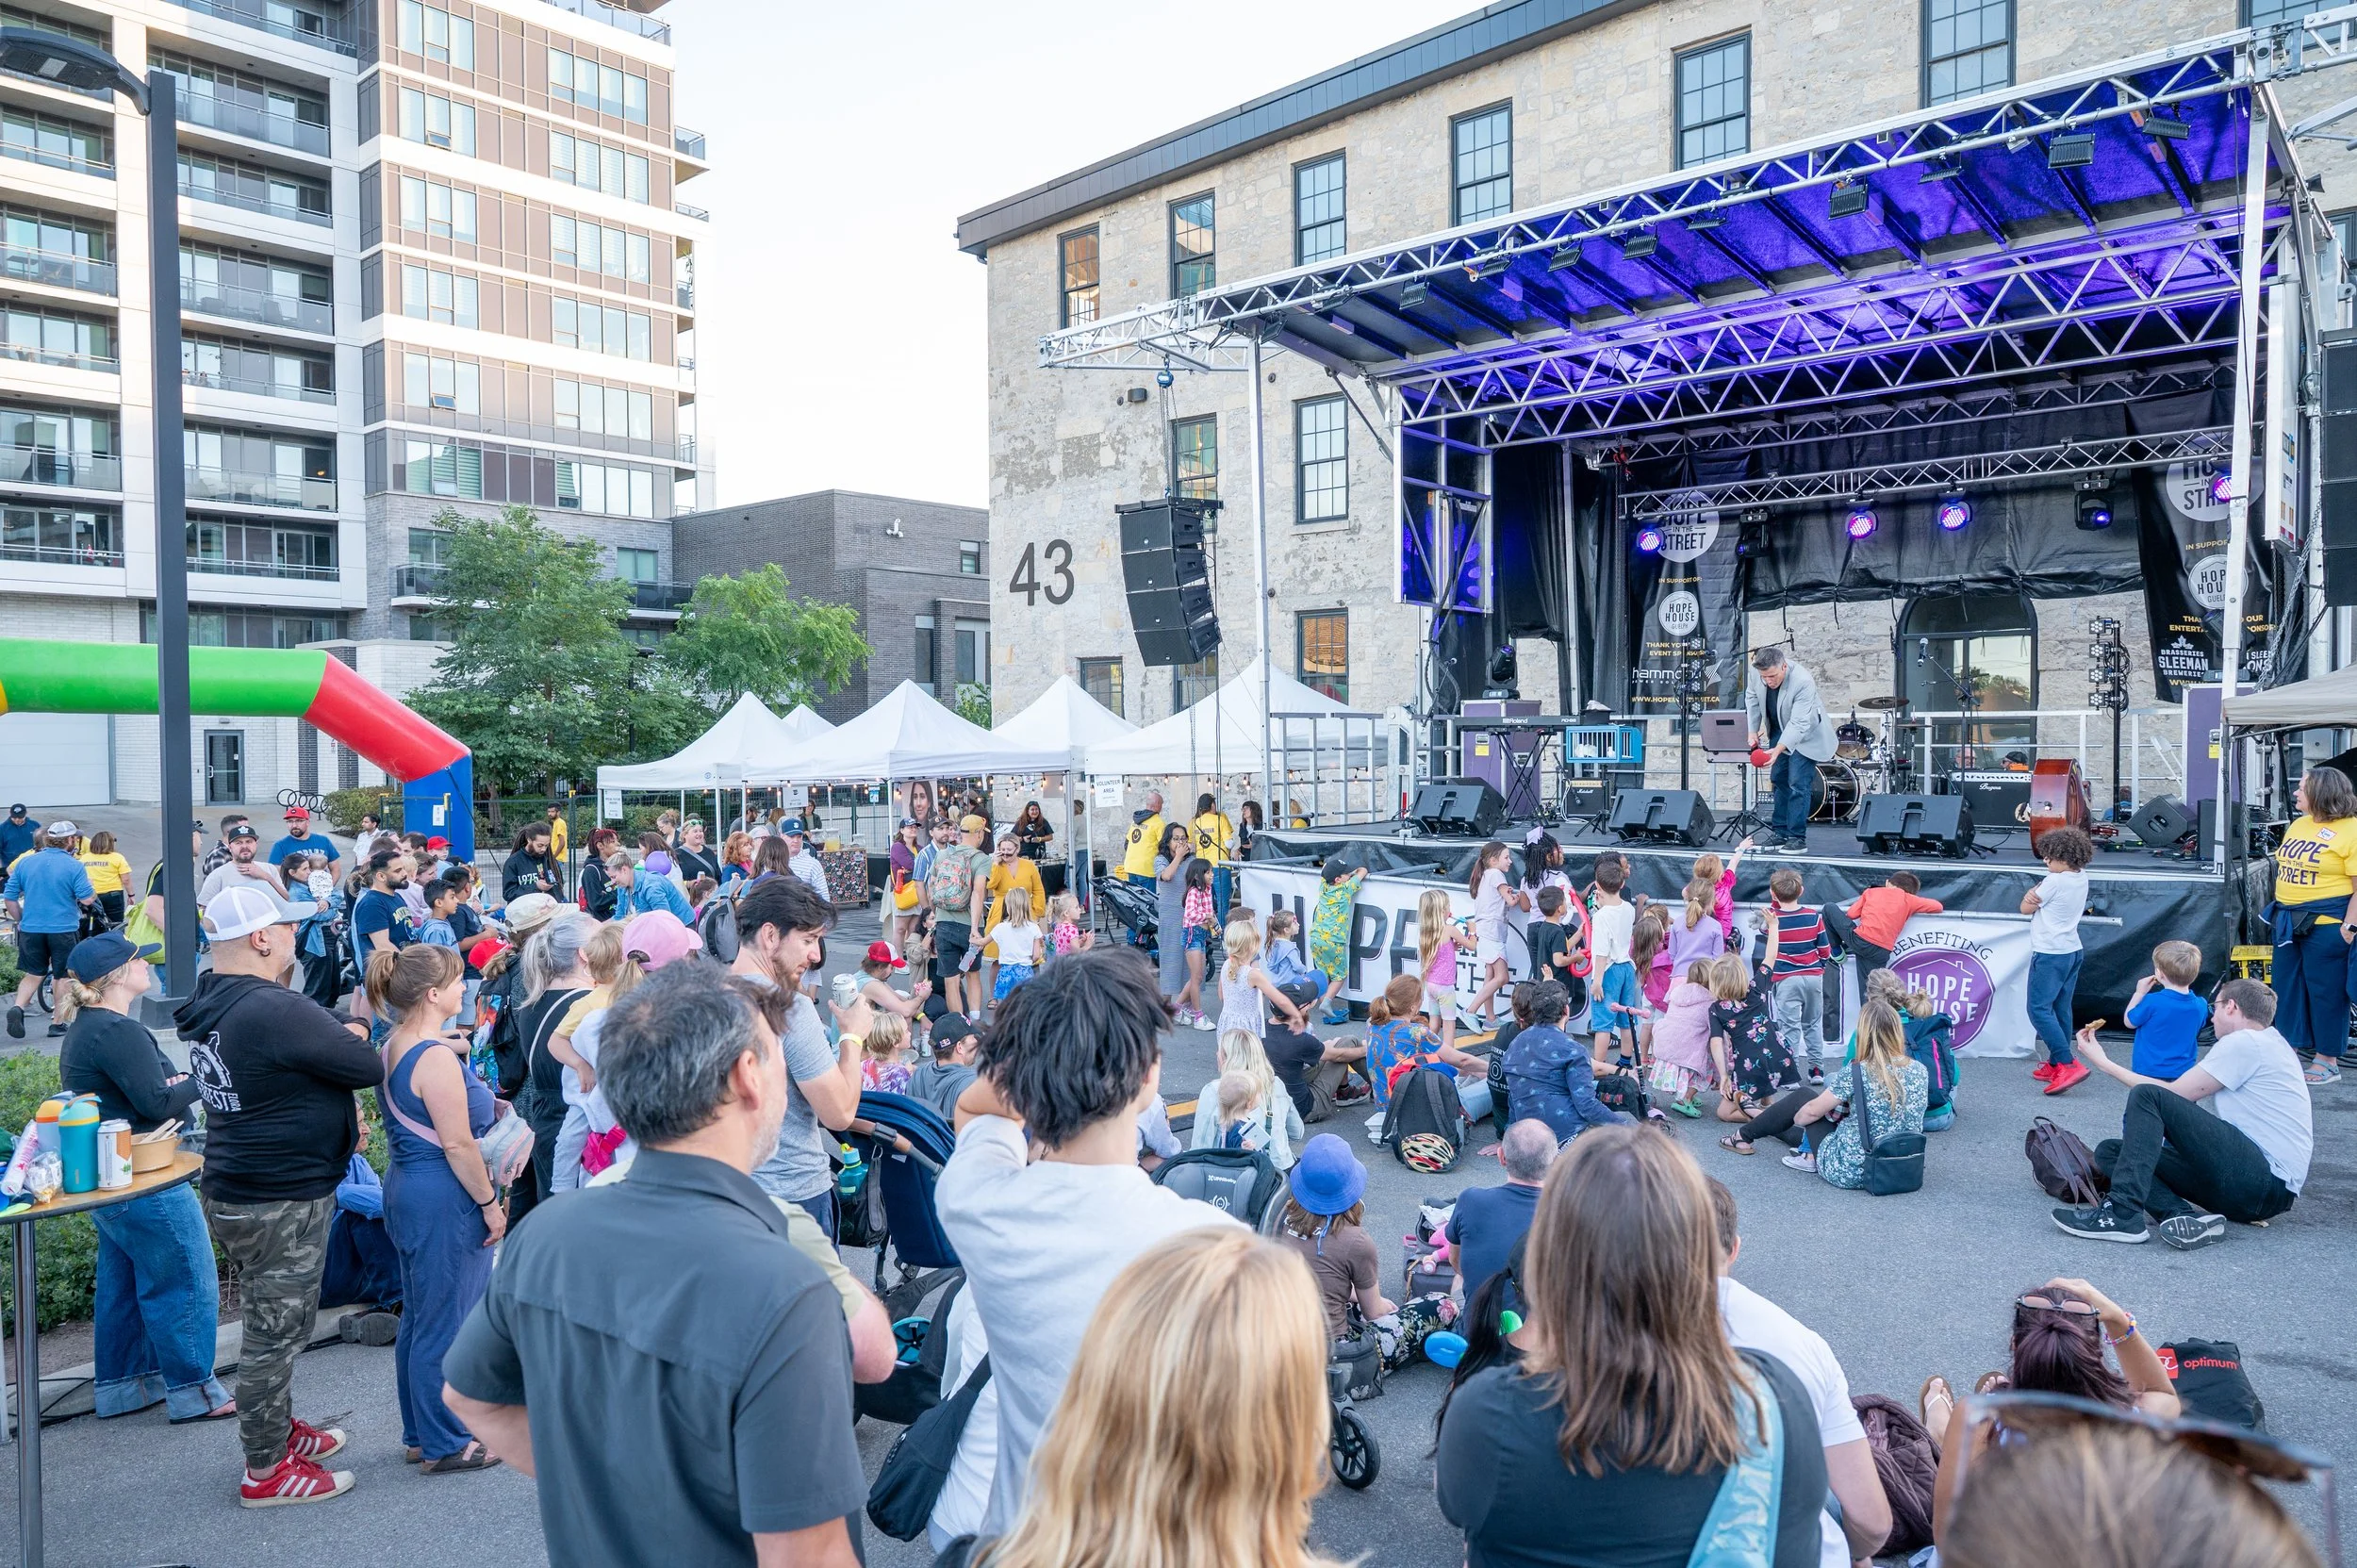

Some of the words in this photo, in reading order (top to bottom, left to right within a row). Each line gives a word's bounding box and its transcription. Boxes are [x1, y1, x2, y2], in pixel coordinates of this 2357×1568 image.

[2195, 539, 2229, 550] SUPPOR
[1010, 538, 1075, 606] 43
[2200, 569, 2226, 583] HOP
[2198, 581, 2223, 595] HOU
[1669, 602, 1692, 613] HOPE
[1665, 612, 1695, 622] HOUSE
[2246, 614, 2264, 623] OUR
[2160, 649, 2204, 657] BRASSERIES
[2158, 655, 2209, 671] SLEEMAN
[1096, 779, 1121, 787] VOLUNTEER
[2278, 837, 2330, 864] HOPE
[2293, 860, 2303, 868] THE
[518, 872, 539, 886] 1975
[1891, 932, 1994, 961] BENEFITING
[1906, 972, 1973, 1002] HOPE
[2183, 1356, 2239, 1371] optimum
